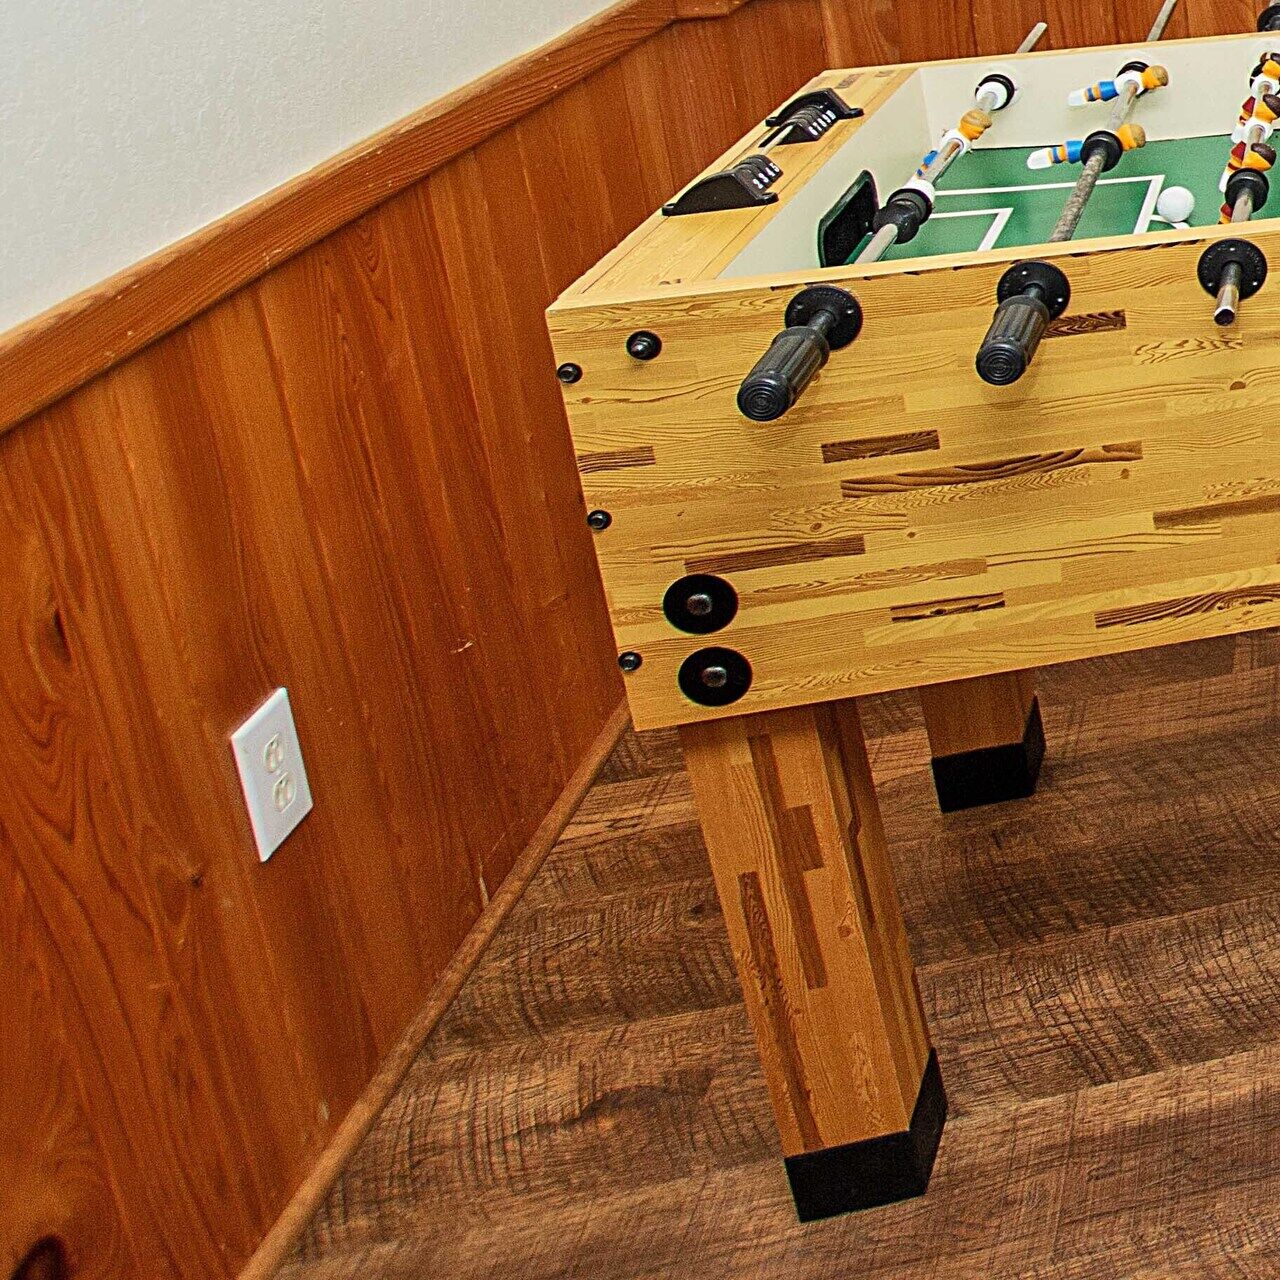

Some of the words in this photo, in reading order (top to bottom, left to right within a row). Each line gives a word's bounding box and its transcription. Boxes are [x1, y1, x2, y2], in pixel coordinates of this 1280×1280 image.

[808, 126, 818, 136] 6
[817, 118, 827, 127] 8
[822, 114, 832, 123] 9
[752, 178, 763, 189] 2
[759, 173, 769, 183] 3
[765, 167, 775, 177] 4
[770, 163, 780, 173] 5
